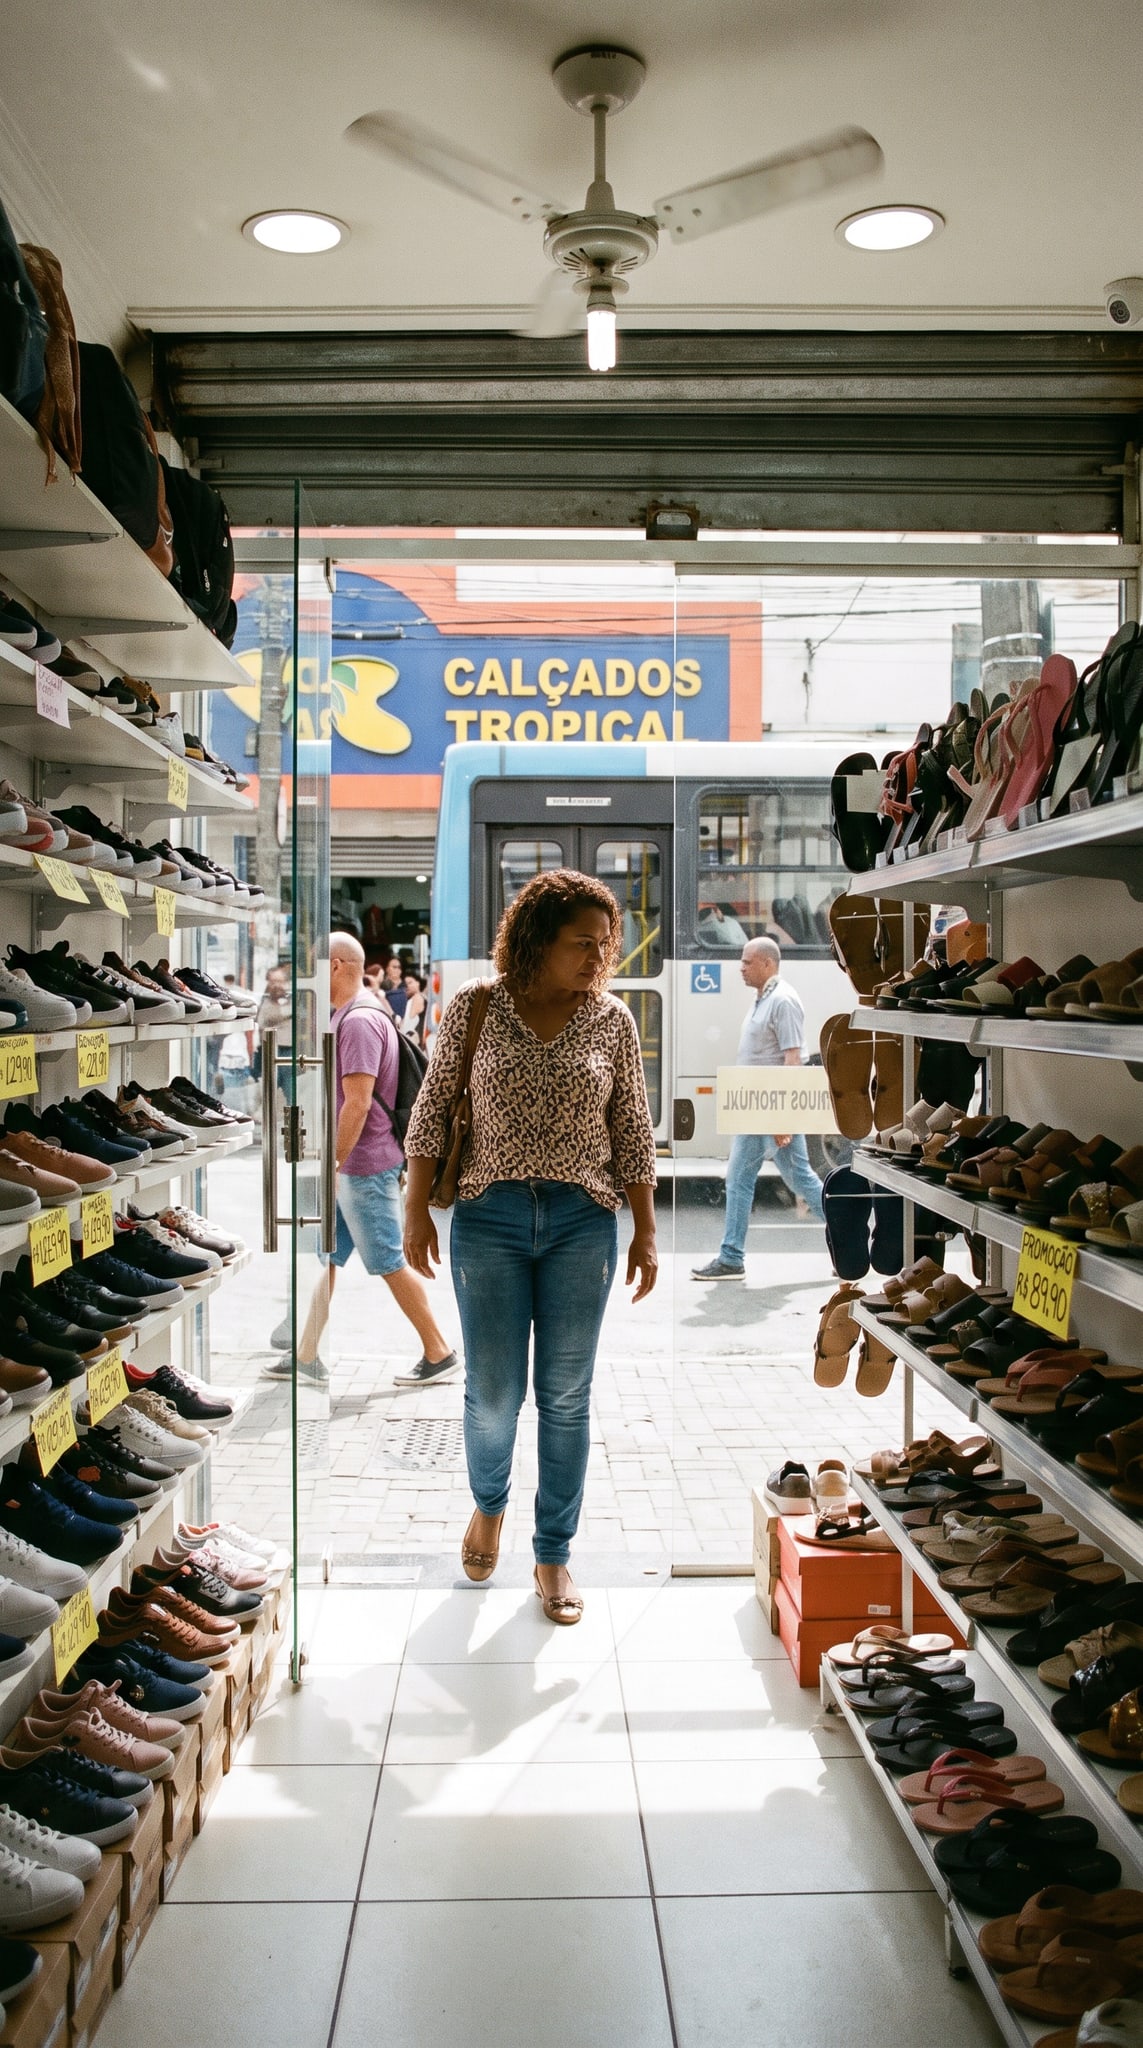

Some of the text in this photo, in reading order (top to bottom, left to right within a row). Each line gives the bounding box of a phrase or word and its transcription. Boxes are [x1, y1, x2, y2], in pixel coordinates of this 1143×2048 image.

[444, 658, 702, 708] CALÇADOS
[445, 710, 700, 742] TROPICAL
[1022, 1231, 1073, 1276] PROMOÇÃO
[1016, 1272, 1068, 1322] R$ 89.90
